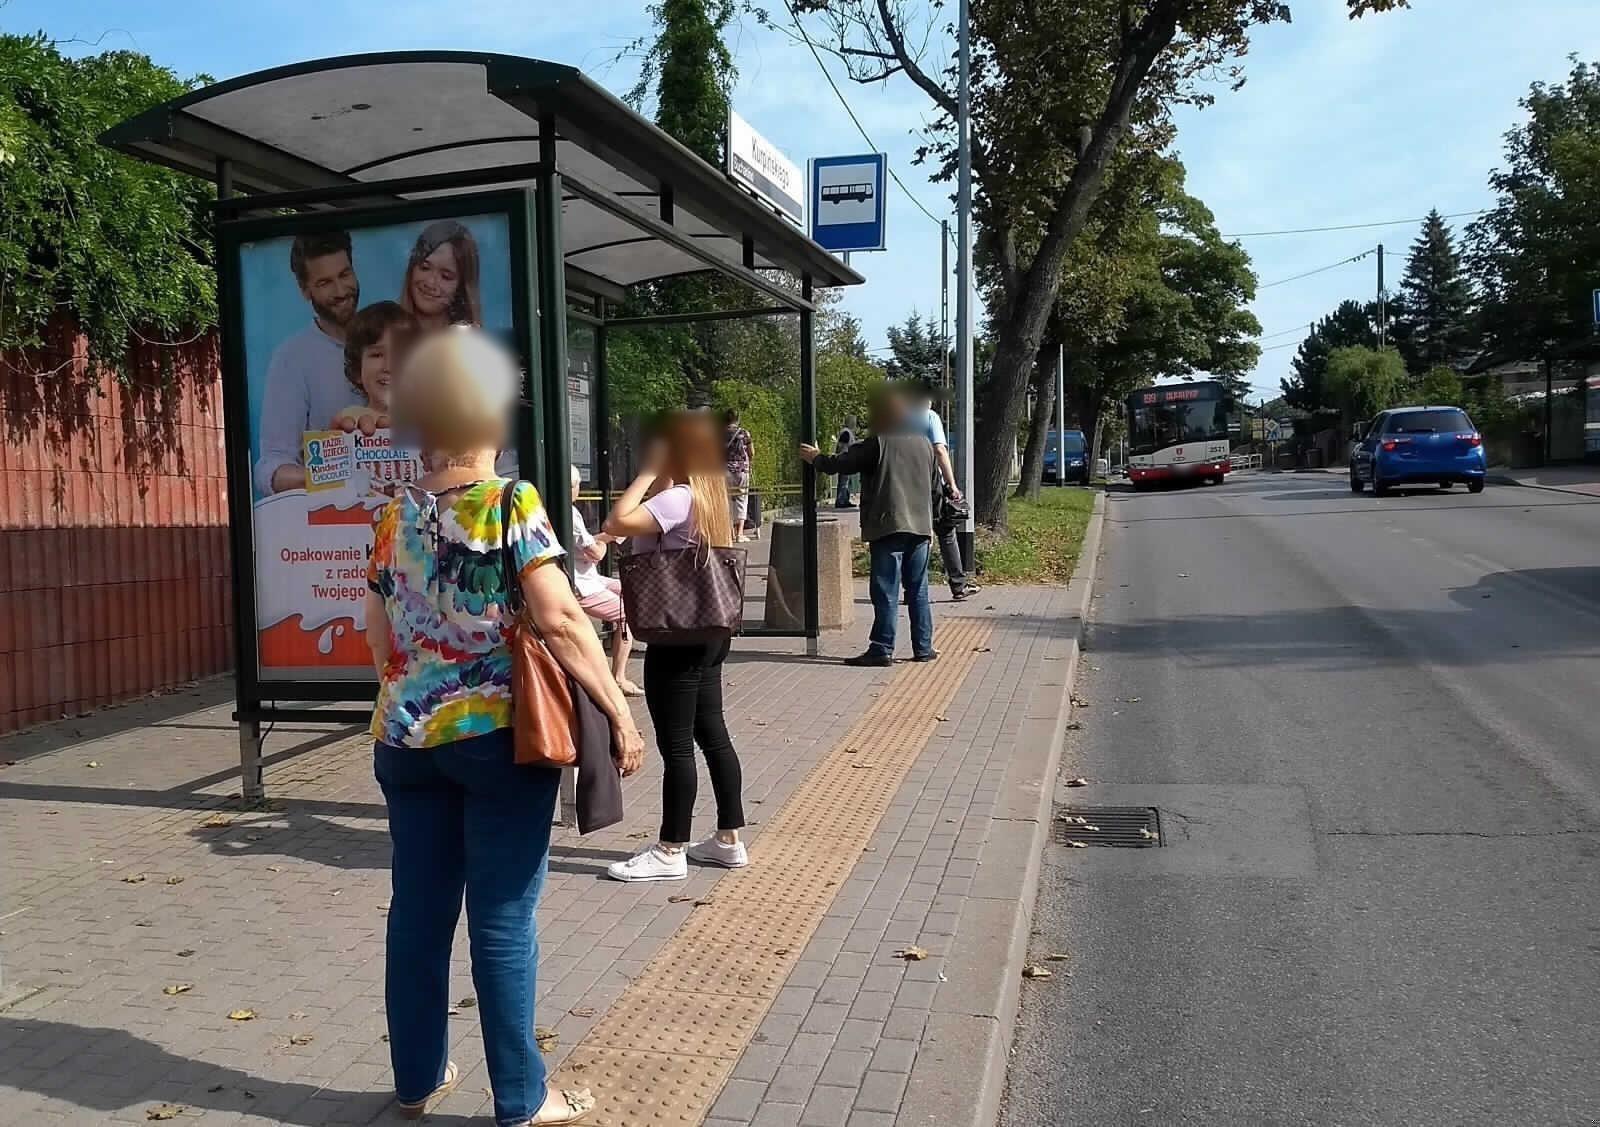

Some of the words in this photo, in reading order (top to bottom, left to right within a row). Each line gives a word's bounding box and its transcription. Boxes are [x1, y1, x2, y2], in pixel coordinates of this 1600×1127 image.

[354, 434, 391, 448] Kinde
[323, 446, 349, 458] DZIECKO
[354, 448, 409, 460] CHOCOLATE
[280, 546, 361, 564] Opakowanie
[325, 568, 334, 579] z
[337, 565, 368, 579] rado
[312, 583, 366, 601] Twojego
